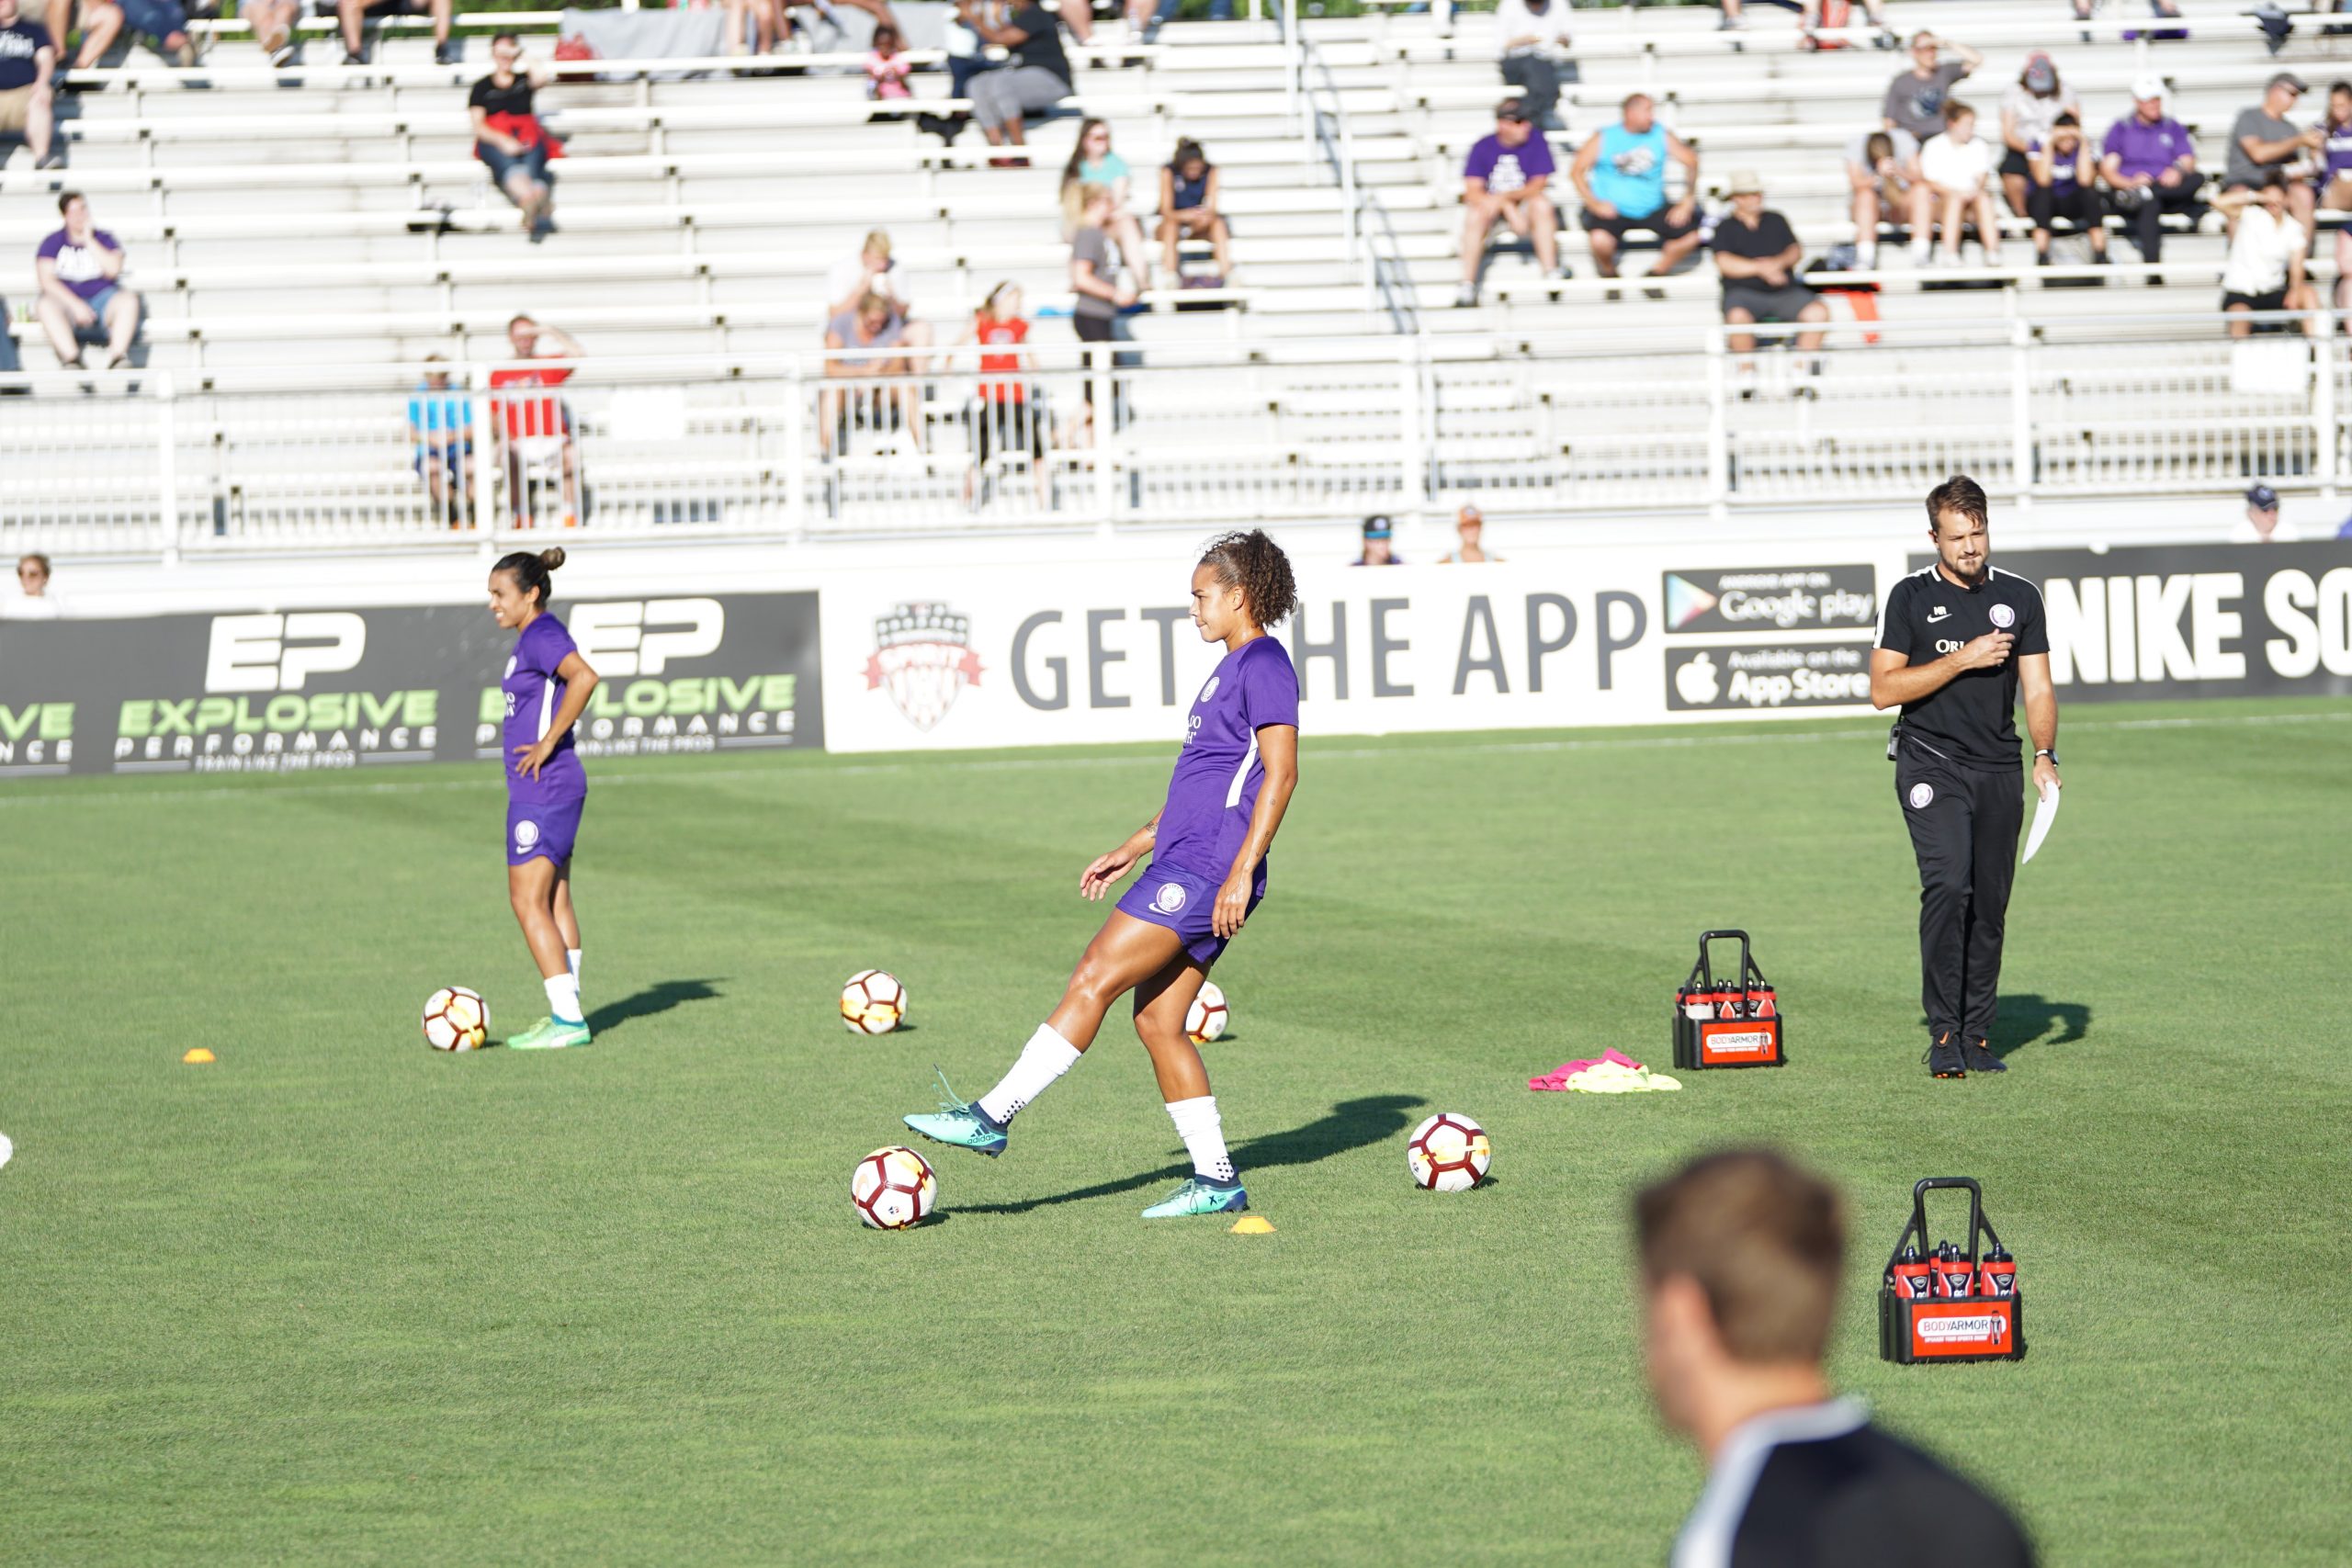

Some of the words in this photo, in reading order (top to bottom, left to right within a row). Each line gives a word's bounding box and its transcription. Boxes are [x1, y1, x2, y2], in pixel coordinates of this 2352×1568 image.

[1719, 588, 1817, 628] Google
[1820, 588, 1874, 626] play
[2044, 571, 2246, 685] NIKE
[205, 612, 366, 694] EP
[568, 597, 725, 677] EP
[1011, 606, 1193, 711] GET
[1292, 595, 1415, 701] HE
[1452, 591, 1648, 695] APP
[1727, 648, 1805, 671] Available
[1830, 646, 1862, 669] the
[118, 689, 439, 739] EXPLOSIVE
[477, 673, 797, 724] ELOSIVE
[114, 726, 437, 760] PERFORMANCE
[967, 1134, 995, 1145] adidas
[1924, 1320, 1988, 1332] BODYARMOR
